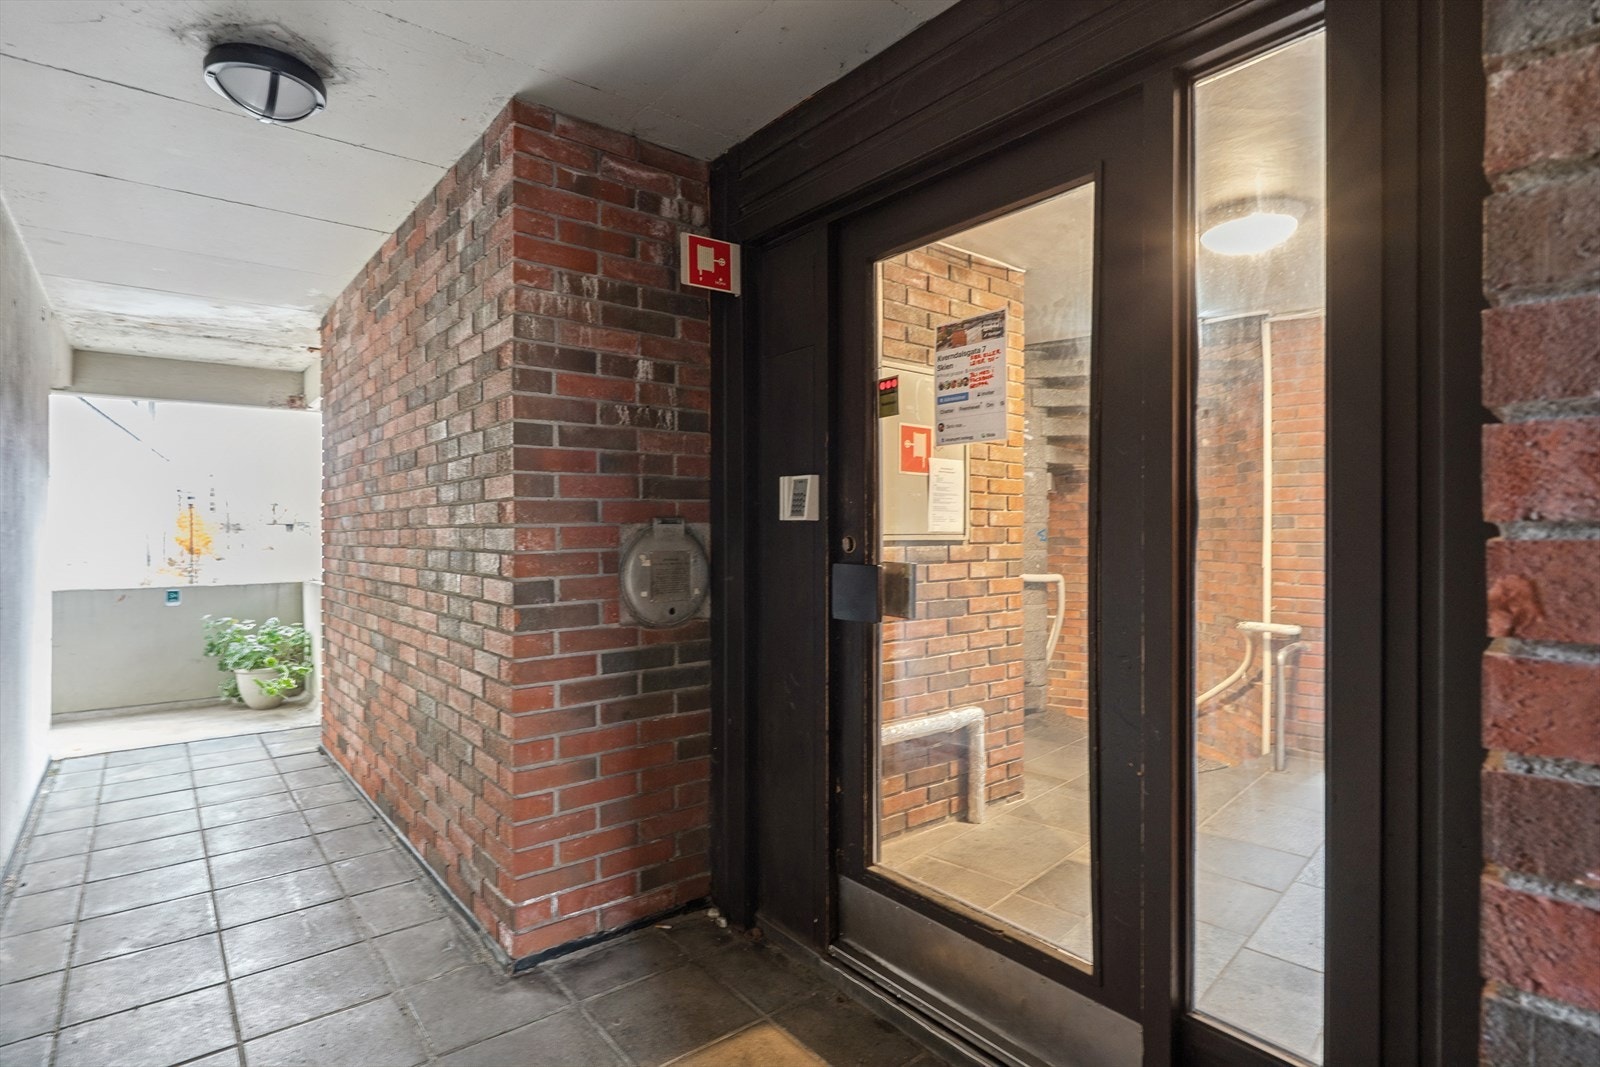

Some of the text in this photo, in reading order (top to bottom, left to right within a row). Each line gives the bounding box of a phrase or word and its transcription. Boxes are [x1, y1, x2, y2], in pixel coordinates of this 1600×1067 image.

[937, 345, 987, 362] Kverndalsgata 7
[937, 363, 954, 371] Skien
